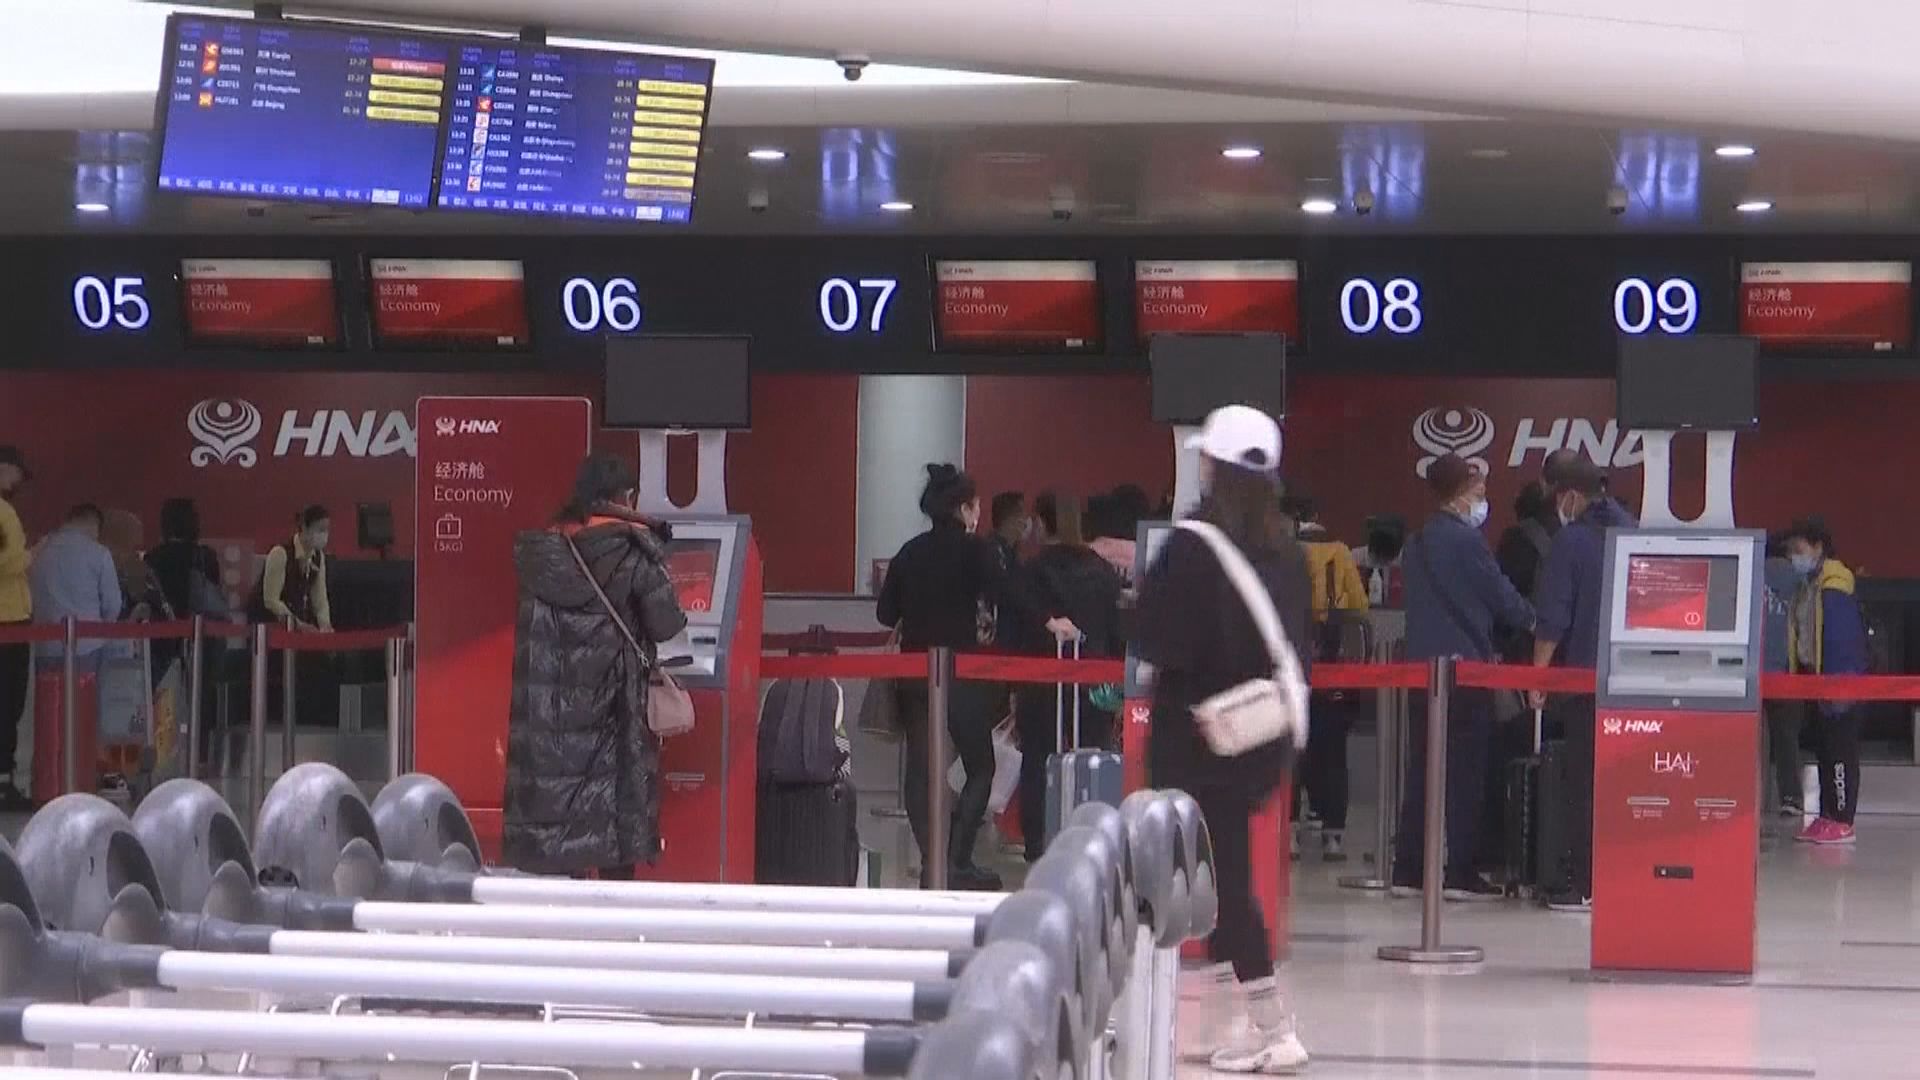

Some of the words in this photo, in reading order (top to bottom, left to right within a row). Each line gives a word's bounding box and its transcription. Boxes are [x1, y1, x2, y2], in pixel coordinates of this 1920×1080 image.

[74, 276, 150, 330] 05
[191, 299, 252, 315] Economy
[380, 299, 441, 316] Economy
[563, 277, 641, 331] 06
[820, 277, 897, 331] 07
[944, 302, 1009, 317] Economy
[1143, 302, 1208, 317] Economy
[1340, 278, 1422, 333] 08
[1614, 278, 1699, 334] 09
[1746, 303, 1817, 321] Economy
[273, 409, 417, 458] HNA
[459, 419, 502, 434] HNA
[435, 461, 485, 480] 经济舱
[434, 485, 513, 508] Economy
[1624, 720, 1663, 733] HNA
